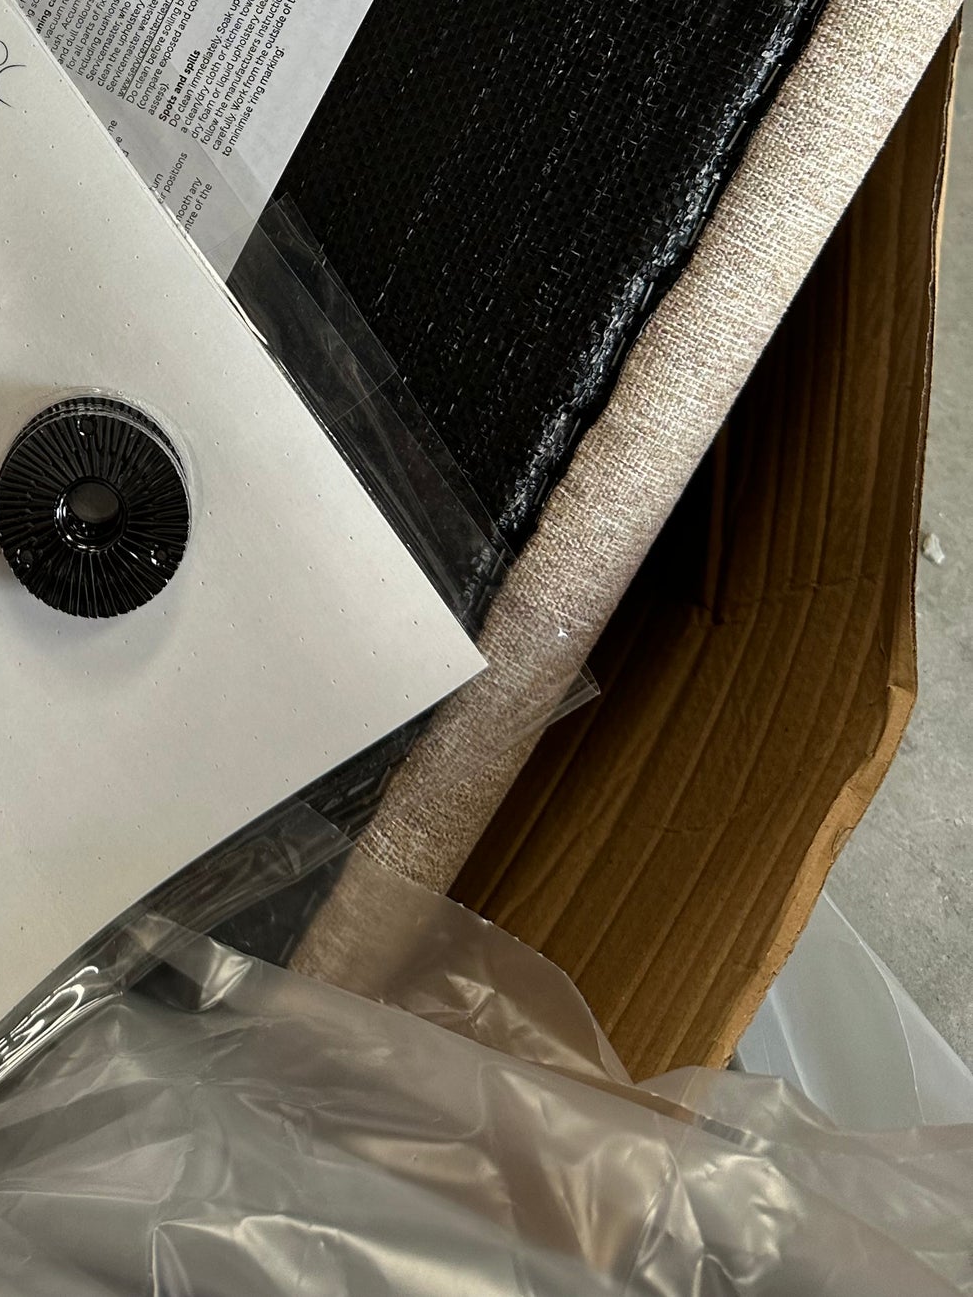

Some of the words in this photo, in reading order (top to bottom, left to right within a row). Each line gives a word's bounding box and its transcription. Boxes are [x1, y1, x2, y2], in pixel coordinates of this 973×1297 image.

[158, 94, 178, 122] Spots
[173, 74, 188, 95] and
[183, 49, 201, 75] spills
